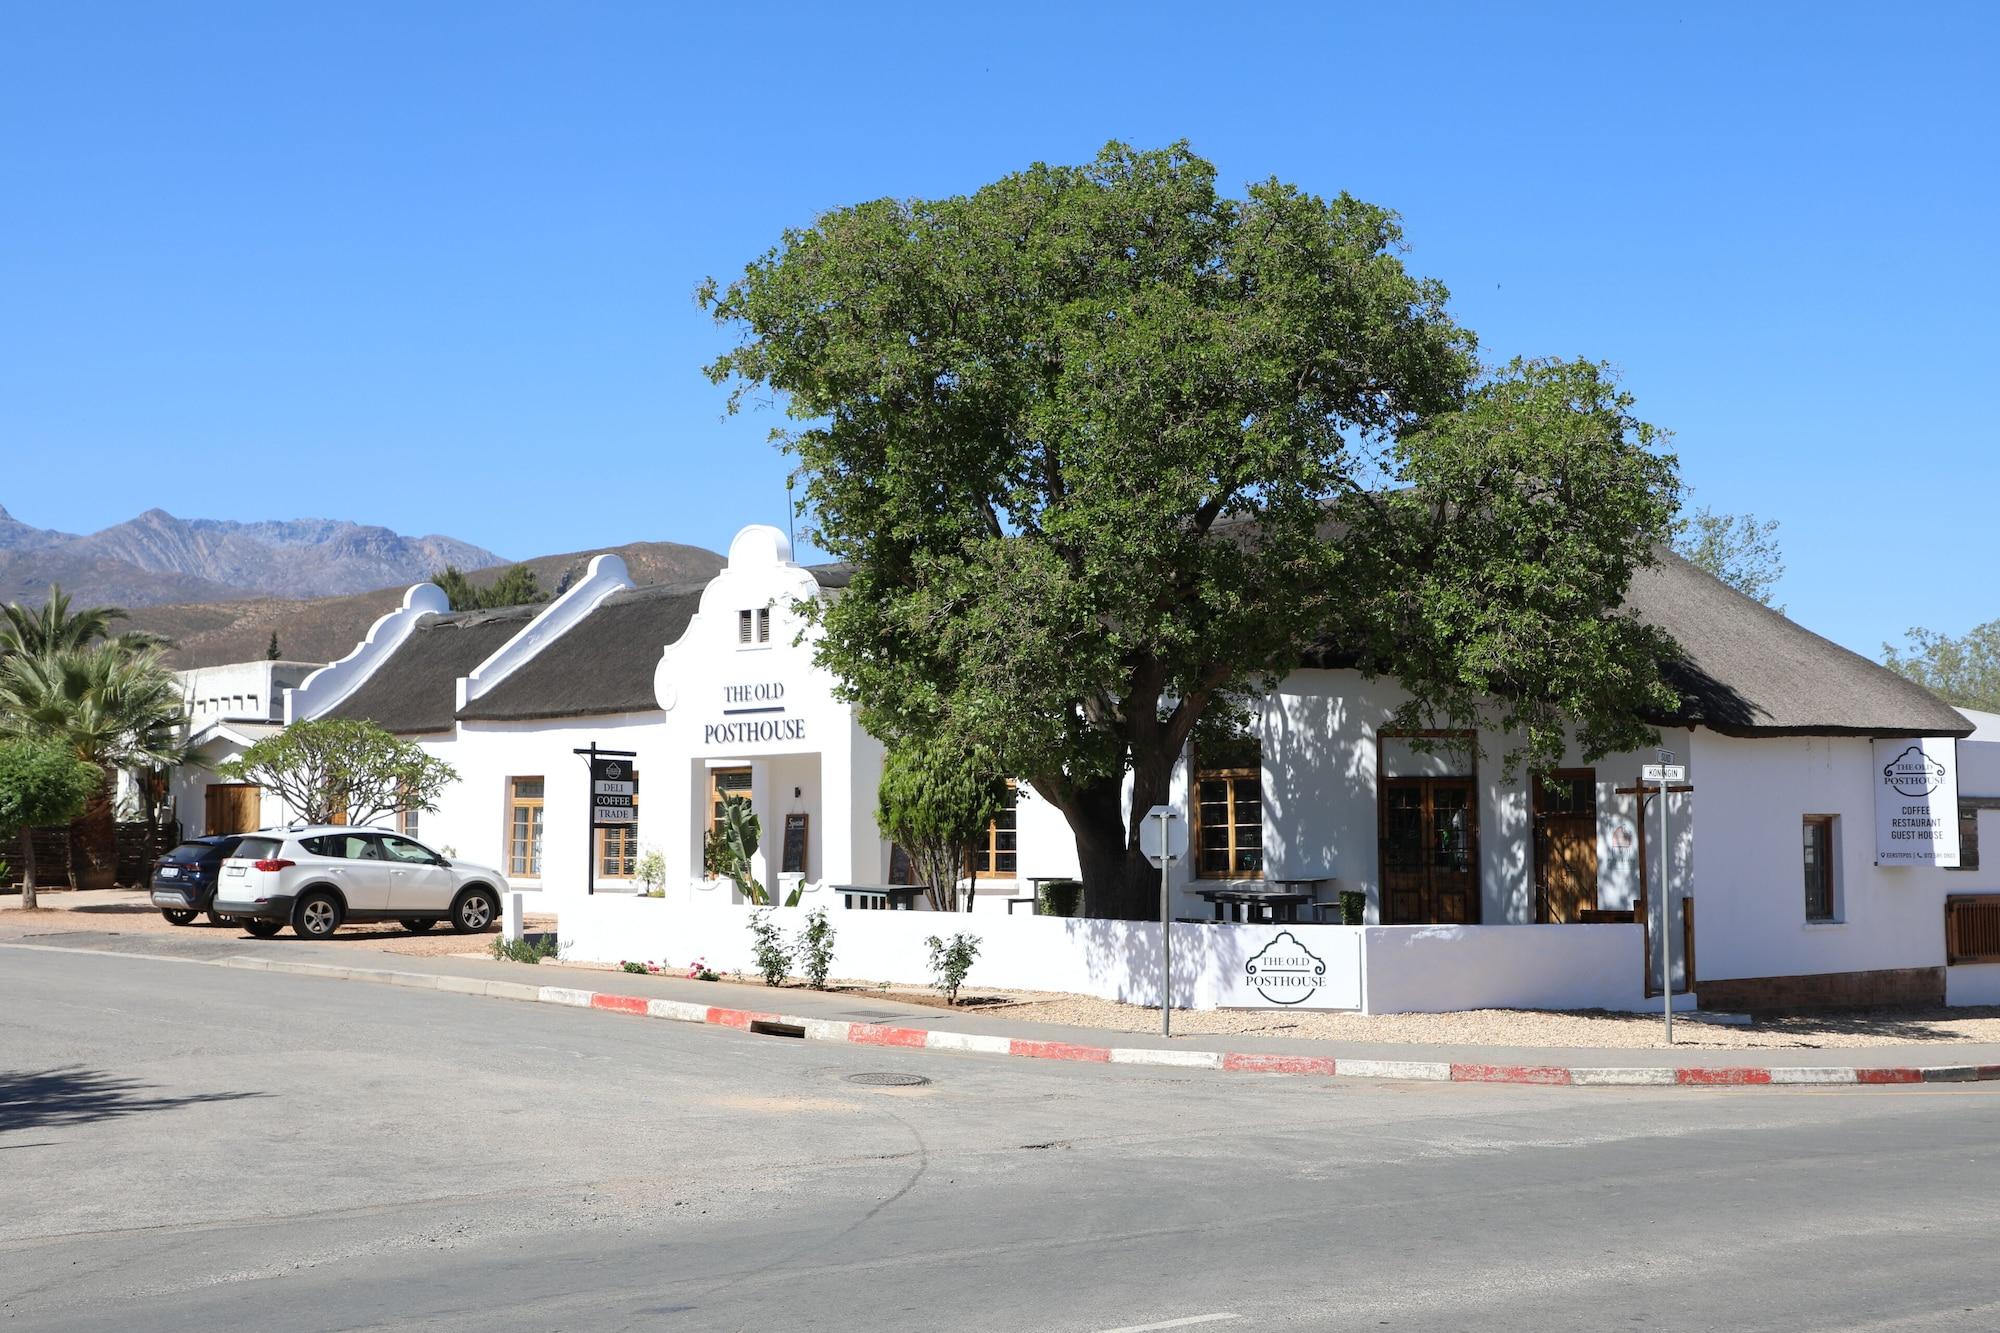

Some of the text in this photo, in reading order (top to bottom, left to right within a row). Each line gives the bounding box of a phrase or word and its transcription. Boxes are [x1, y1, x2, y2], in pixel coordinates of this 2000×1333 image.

[724, 682, 784, 703] THE OLD
[704, 719, 806, 744] POSTHOUSE
[1897, 763, 1934, 771] THE OLD
[1884, 776, 1946, 785] POSTHOUSE
[604, 783, 624, 792] DELI
[597, 796, 631, 806] COFFEE
[599, 809, 629, 819] TRADE
[1902, 806, 1931, 815] COFFEE
[1892, 818, 1942, 828] RESTAURANT
[1891, 830, 1944, 840] GUEST HOUSE
[1262, 957, 1310, 966] THE OLD
[1246, 975, 1327, 987] POSTHOUSE
